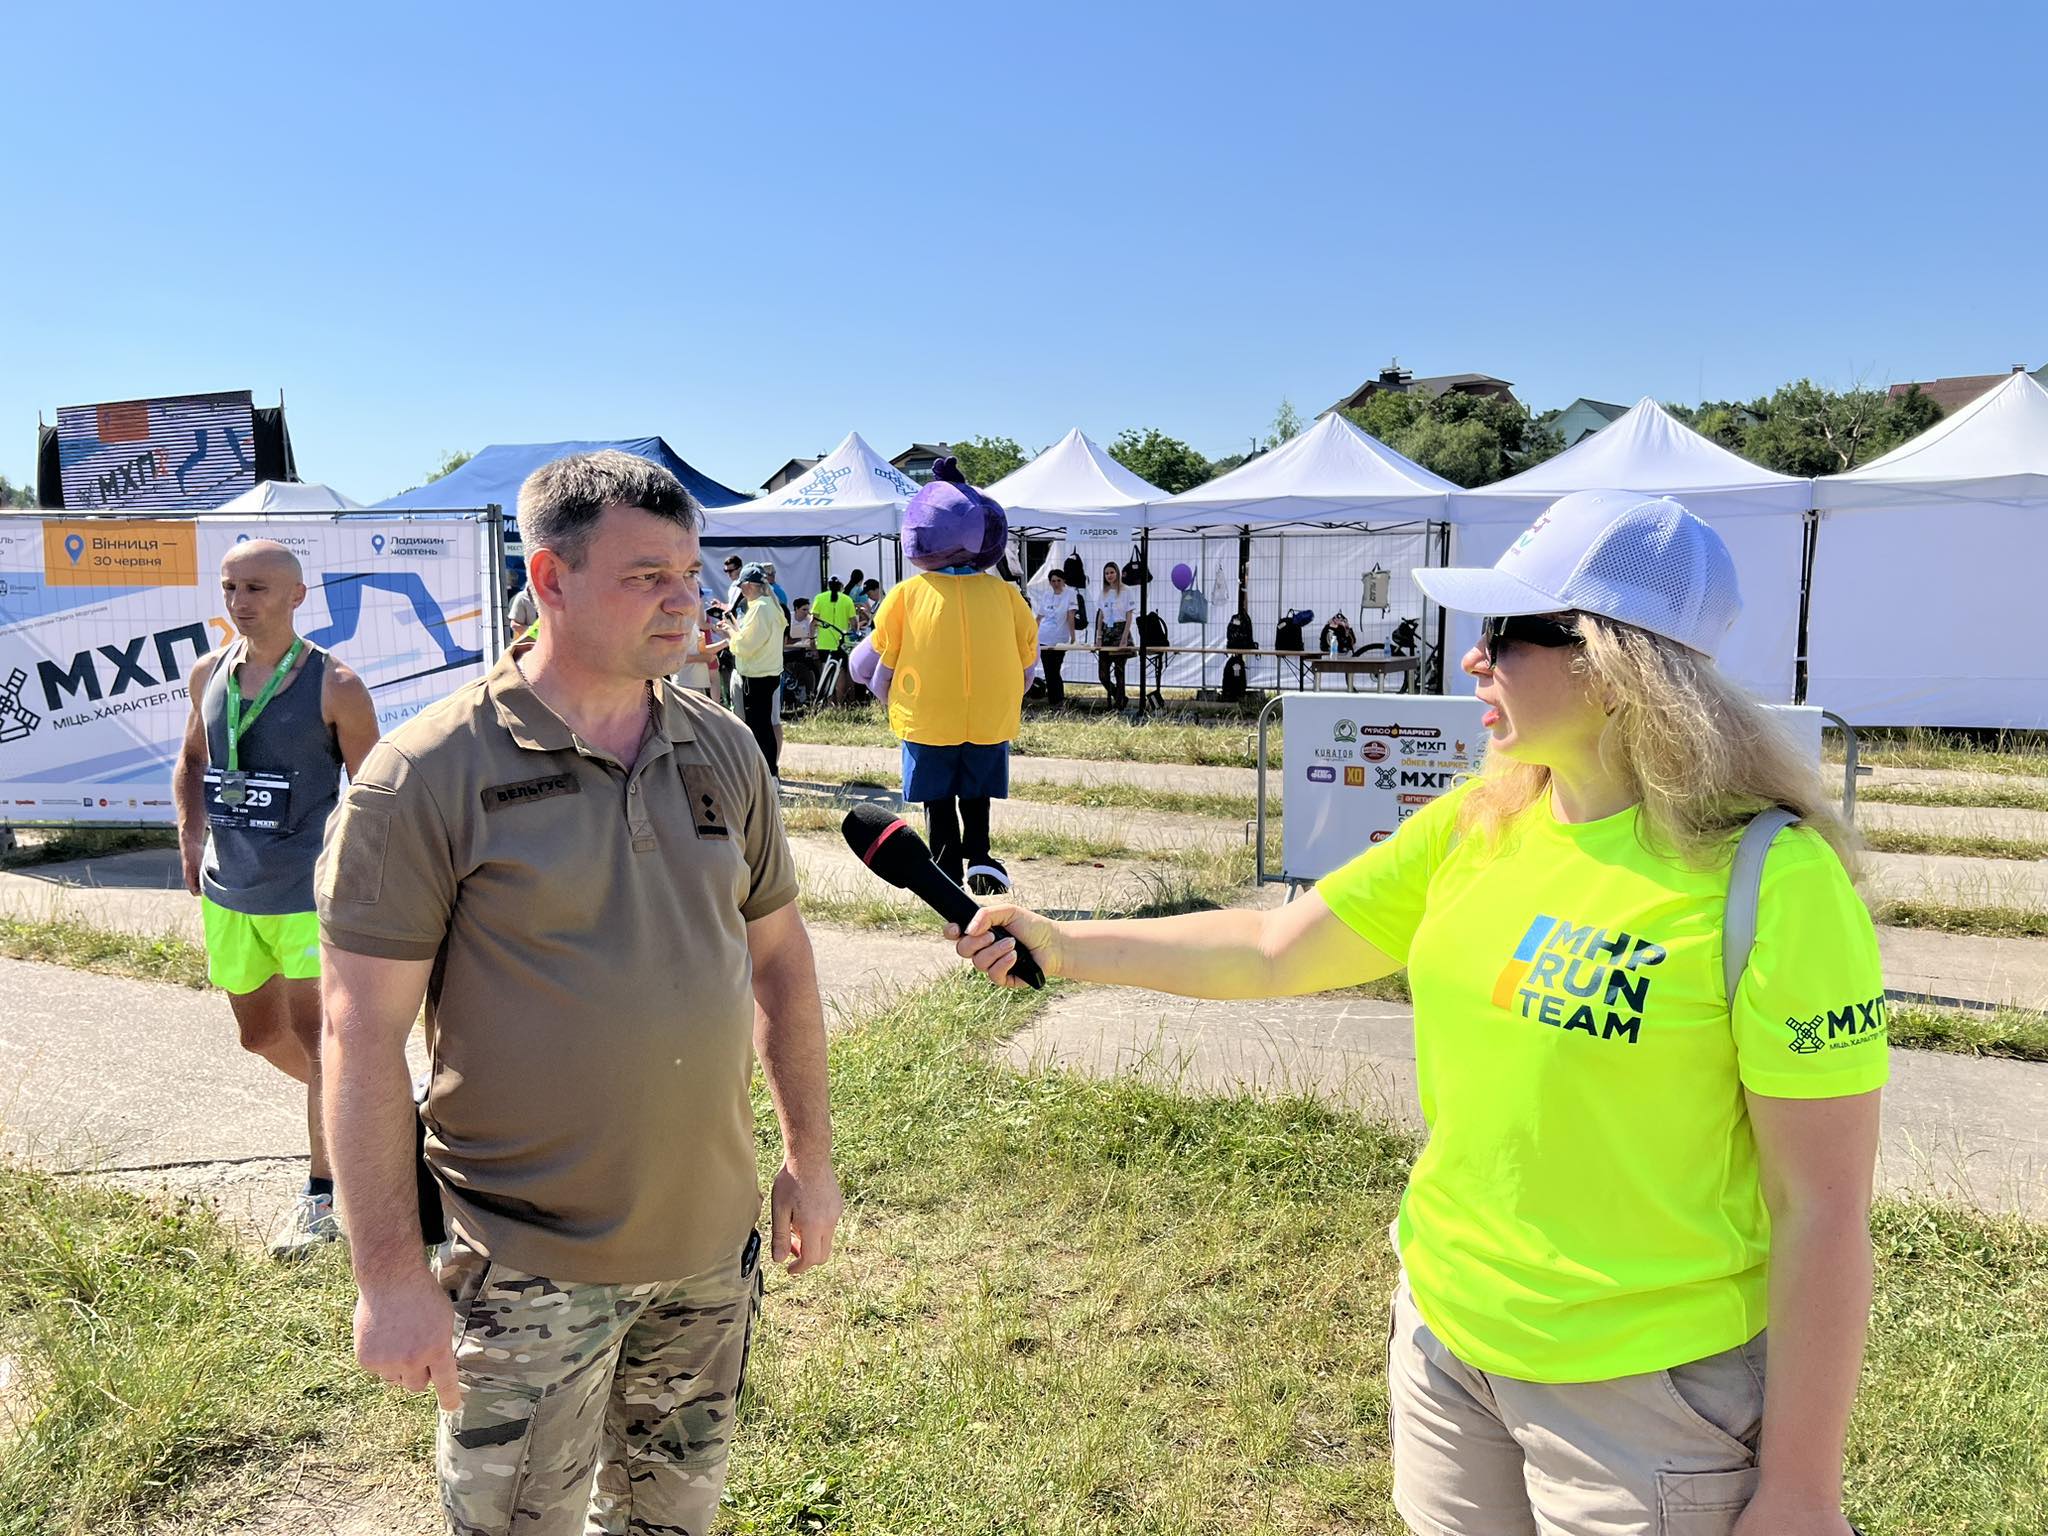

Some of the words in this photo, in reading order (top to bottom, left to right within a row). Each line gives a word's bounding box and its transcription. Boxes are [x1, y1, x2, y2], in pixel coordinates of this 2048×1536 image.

[781, 497, 835, 506] МХП
[1080, 528, 1118, 536] ГАРДЕРОБ
[92, 537, 159, 551] Вінниця
[390, 535, 444, 546] Ладижин
[390, 547, 438, 556] жовтень
[93, 556, 112, 566] 30
[114, 557, 162, 567] червня
[36, 621, 211, 712] МХП
[53, 711, 94, 730] МІЦЬ.
[93, 692, 170, 720] ХАРАКТЕР.
[1398, 728, 1438, 736] МАРКЕТ
[1416, 741, 1447, 751] МХП
[1314, 748, 1354, 758] KURATOR
[1400, 771, 1457, 788] МХП
[496, 778, 566, 802] ВЕЛЬГУС
[1398, 806, 1414, 817] La
[1546, 920, 1667, 972] MHP
[1526, 951, 1651, 1014] RUN
[1518, 988, 1642, 1044] TEAM
[1826, 994, 1886, 1039] МХП
